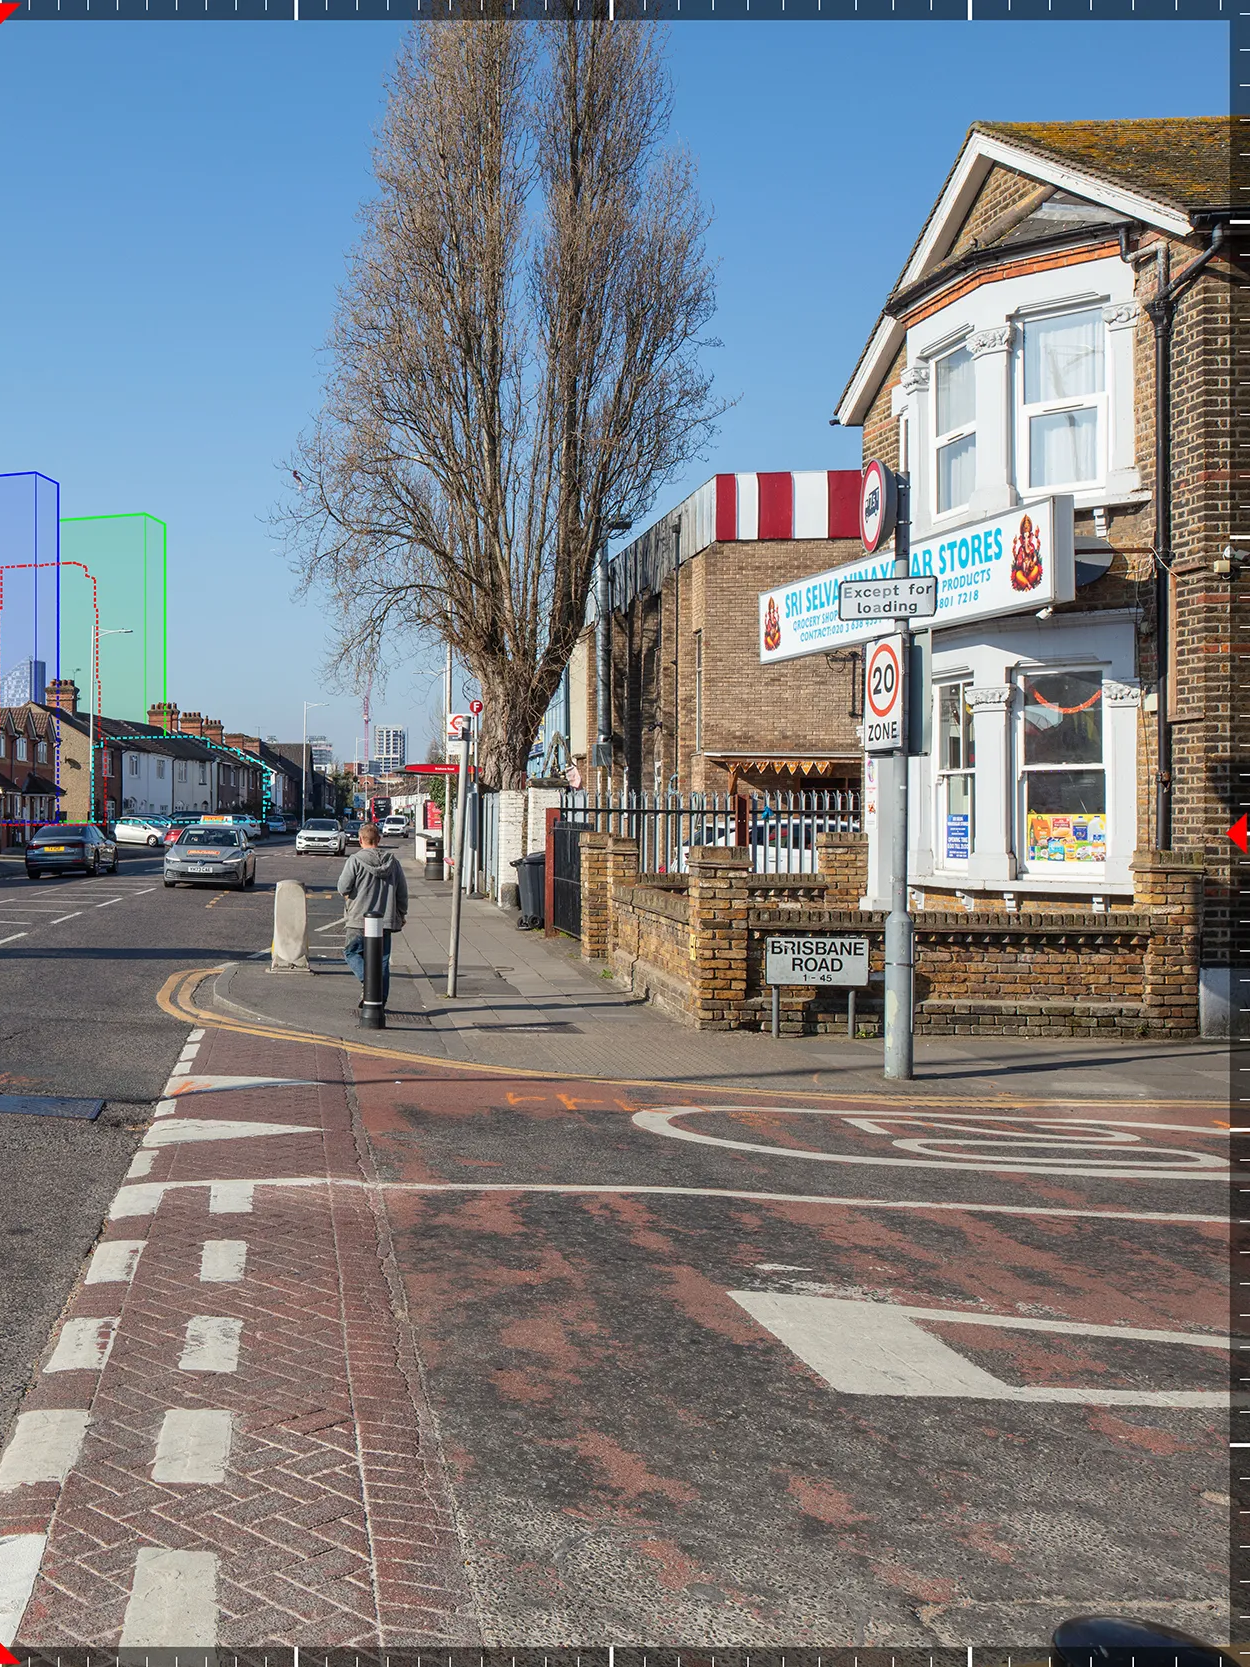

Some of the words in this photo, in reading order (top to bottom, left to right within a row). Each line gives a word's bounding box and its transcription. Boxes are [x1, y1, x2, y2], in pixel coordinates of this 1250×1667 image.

[785, 590, 803, 619] SRI
[938, 527, 1003, 575] STORES
[941, 568, 991, 592] PRODUCTS
[844, 584, 900, 600] Except
[908, 583, 932, 595] for
[957, 589, 979, 605] 7218
[857, 601, 918, 617] loading
[792, 614, 821, 632] GROCERY
[873, 663, 895, 695] 20
[473, 702, 480, 712] F
[868, 721, 897, 742] ZONE
[771, 941, 864, 956] BRISBANE
[792, 957, 843, 972] ROAD
[820, 974, 832, 982] 45
